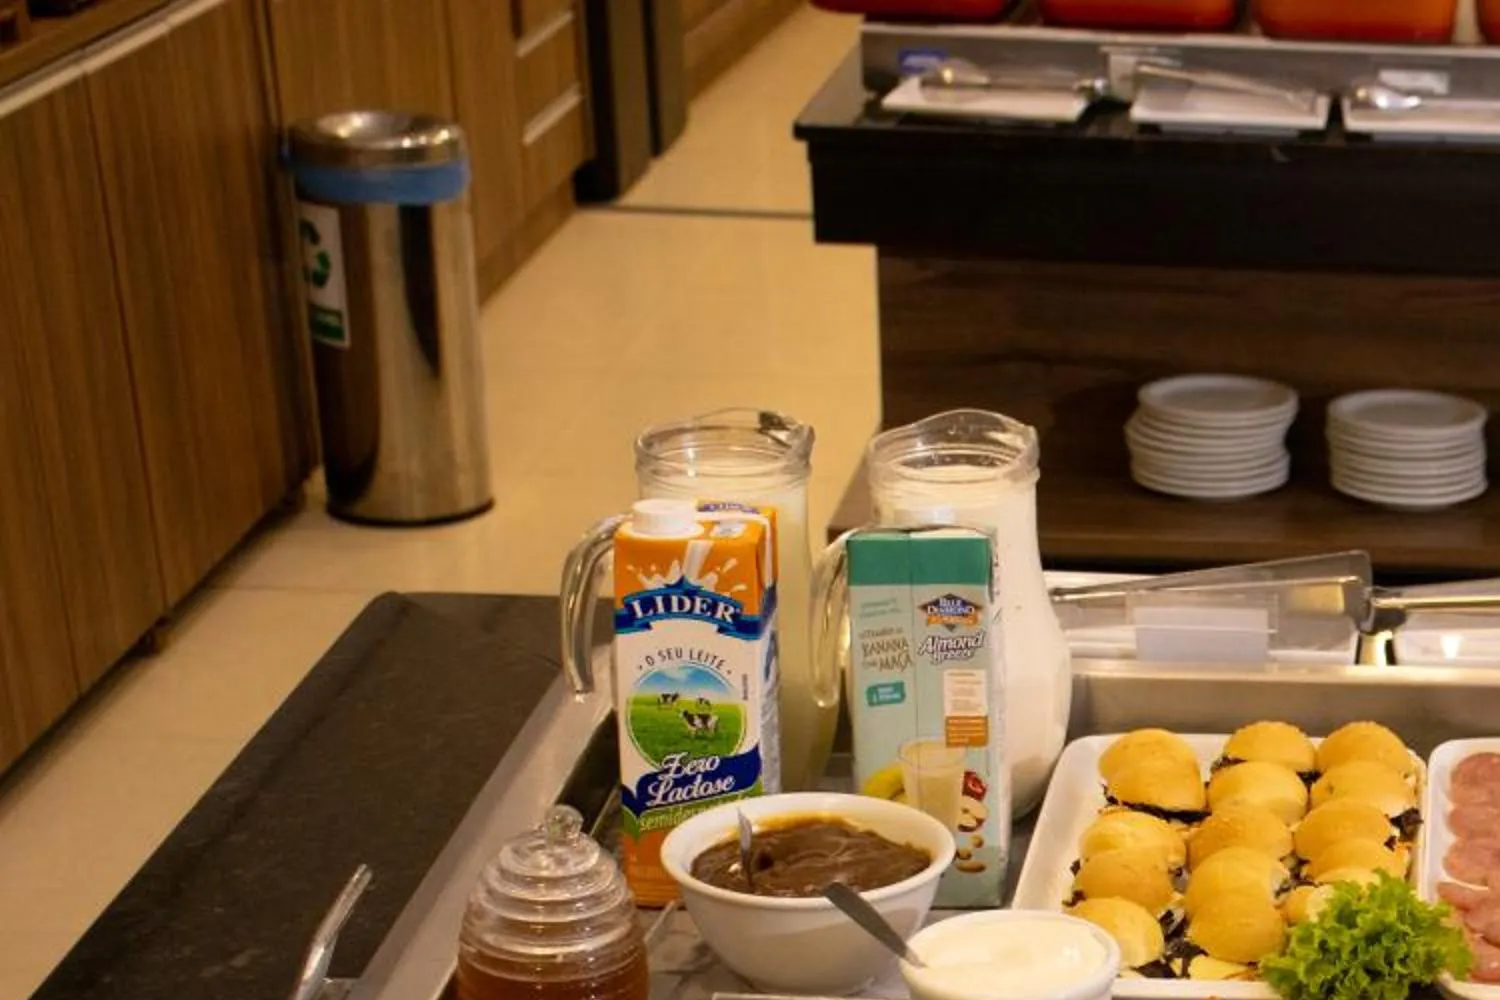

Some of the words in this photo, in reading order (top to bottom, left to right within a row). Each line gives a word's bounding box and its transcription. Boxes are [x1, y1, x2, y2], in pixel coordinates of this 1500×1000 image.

[630, 594, 735, 622] LIDER
[657, 647, 683, 662] SEU
[689, 647, 726, 669] LEITE
[657, 751, 720, 782] Zero
[645, 773, 735, 807] Lactose
